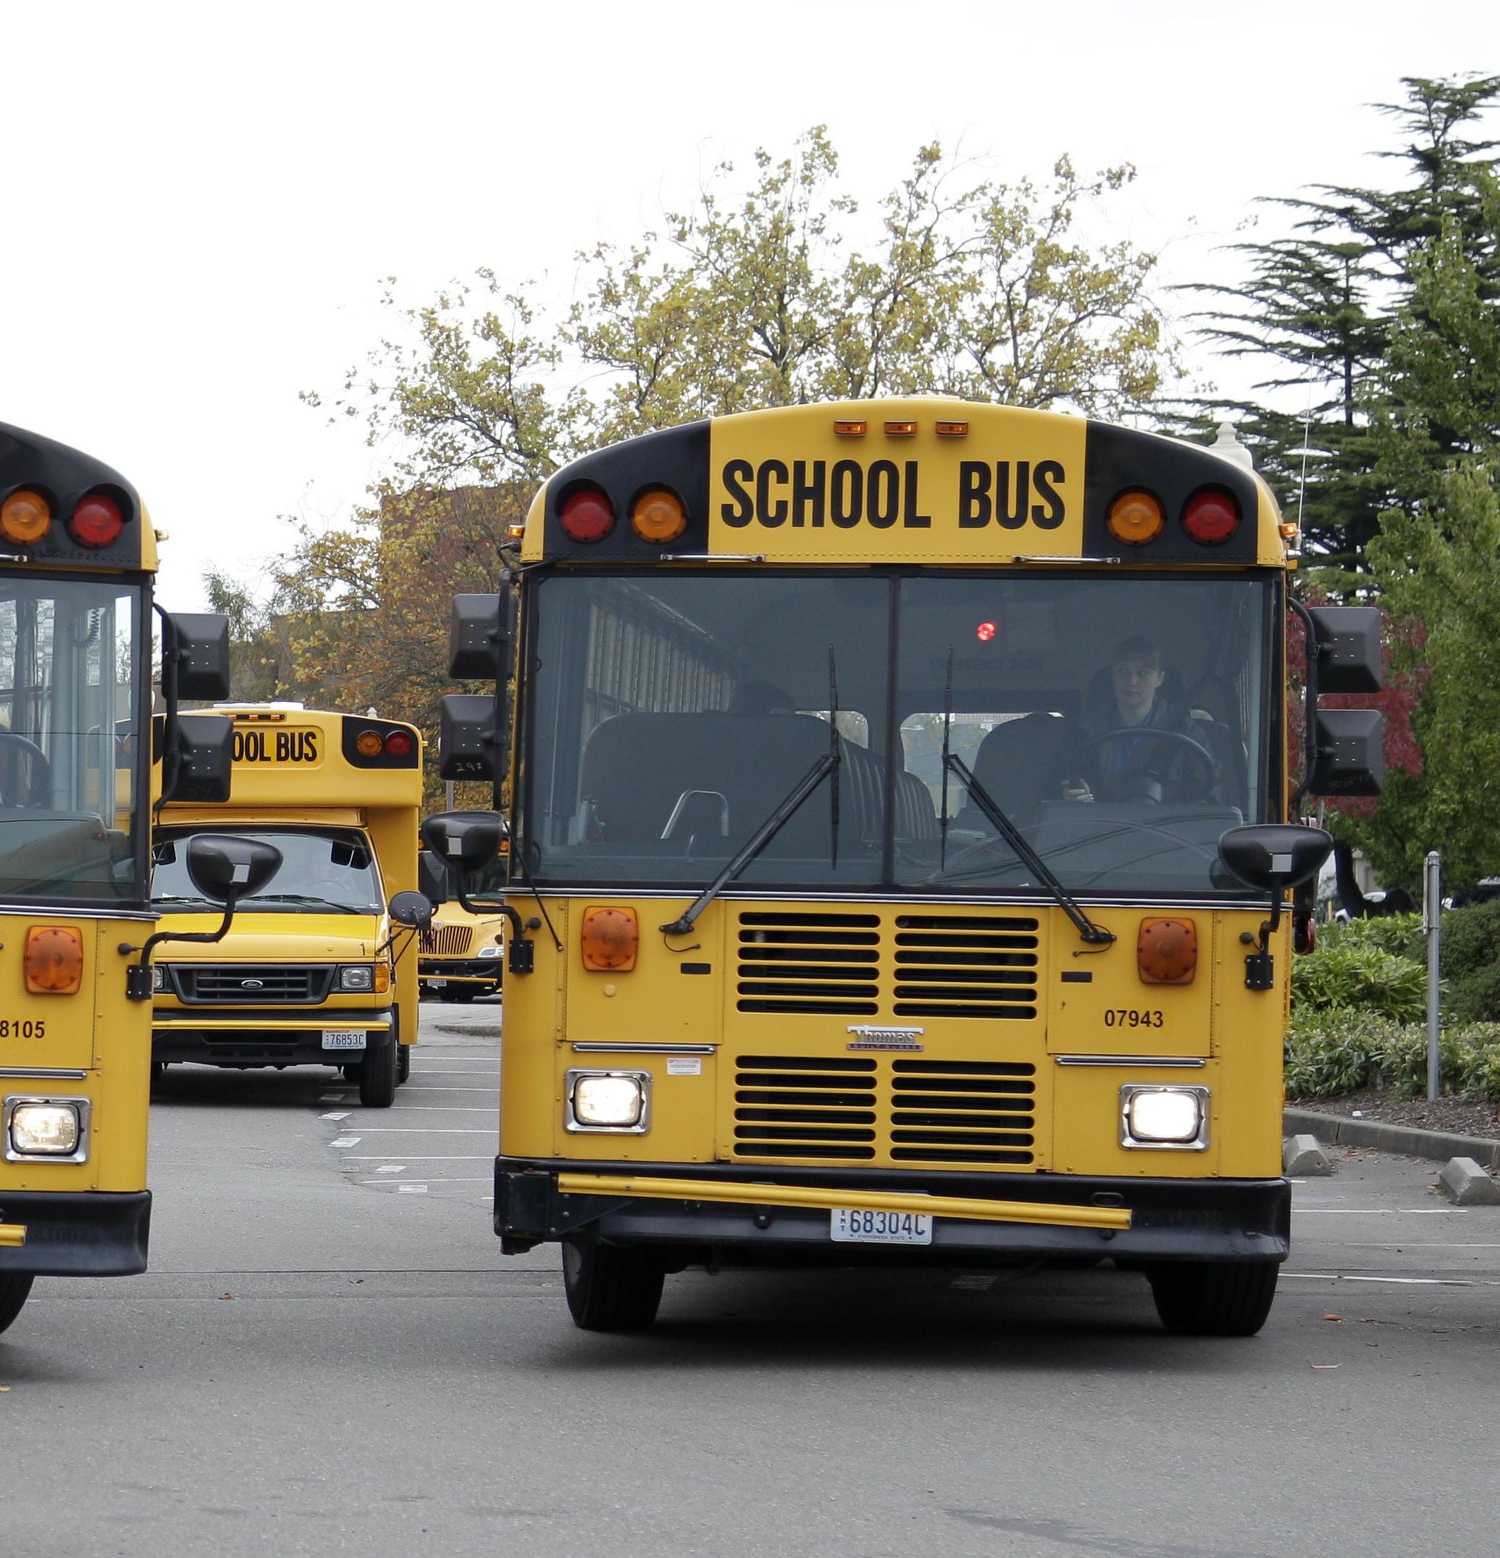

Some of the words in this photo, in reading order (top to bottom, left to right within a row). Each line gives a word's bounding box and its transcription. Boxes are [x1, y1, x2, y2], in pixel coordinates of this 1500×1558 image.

[720, 458, 931, 529] SCHOOL
[958, 459, 1067, 530] BUS
[929, 658, 1003, 671] EMRGENCY
[232, 731, 271, 762] OOL
[276, 731, 317, 762] BUS
[1104, 1009, 1164, 1029] 07943
[331, 1034, 364, 1046] 76853C
[850, 1210, 926, 1236] 68304C
